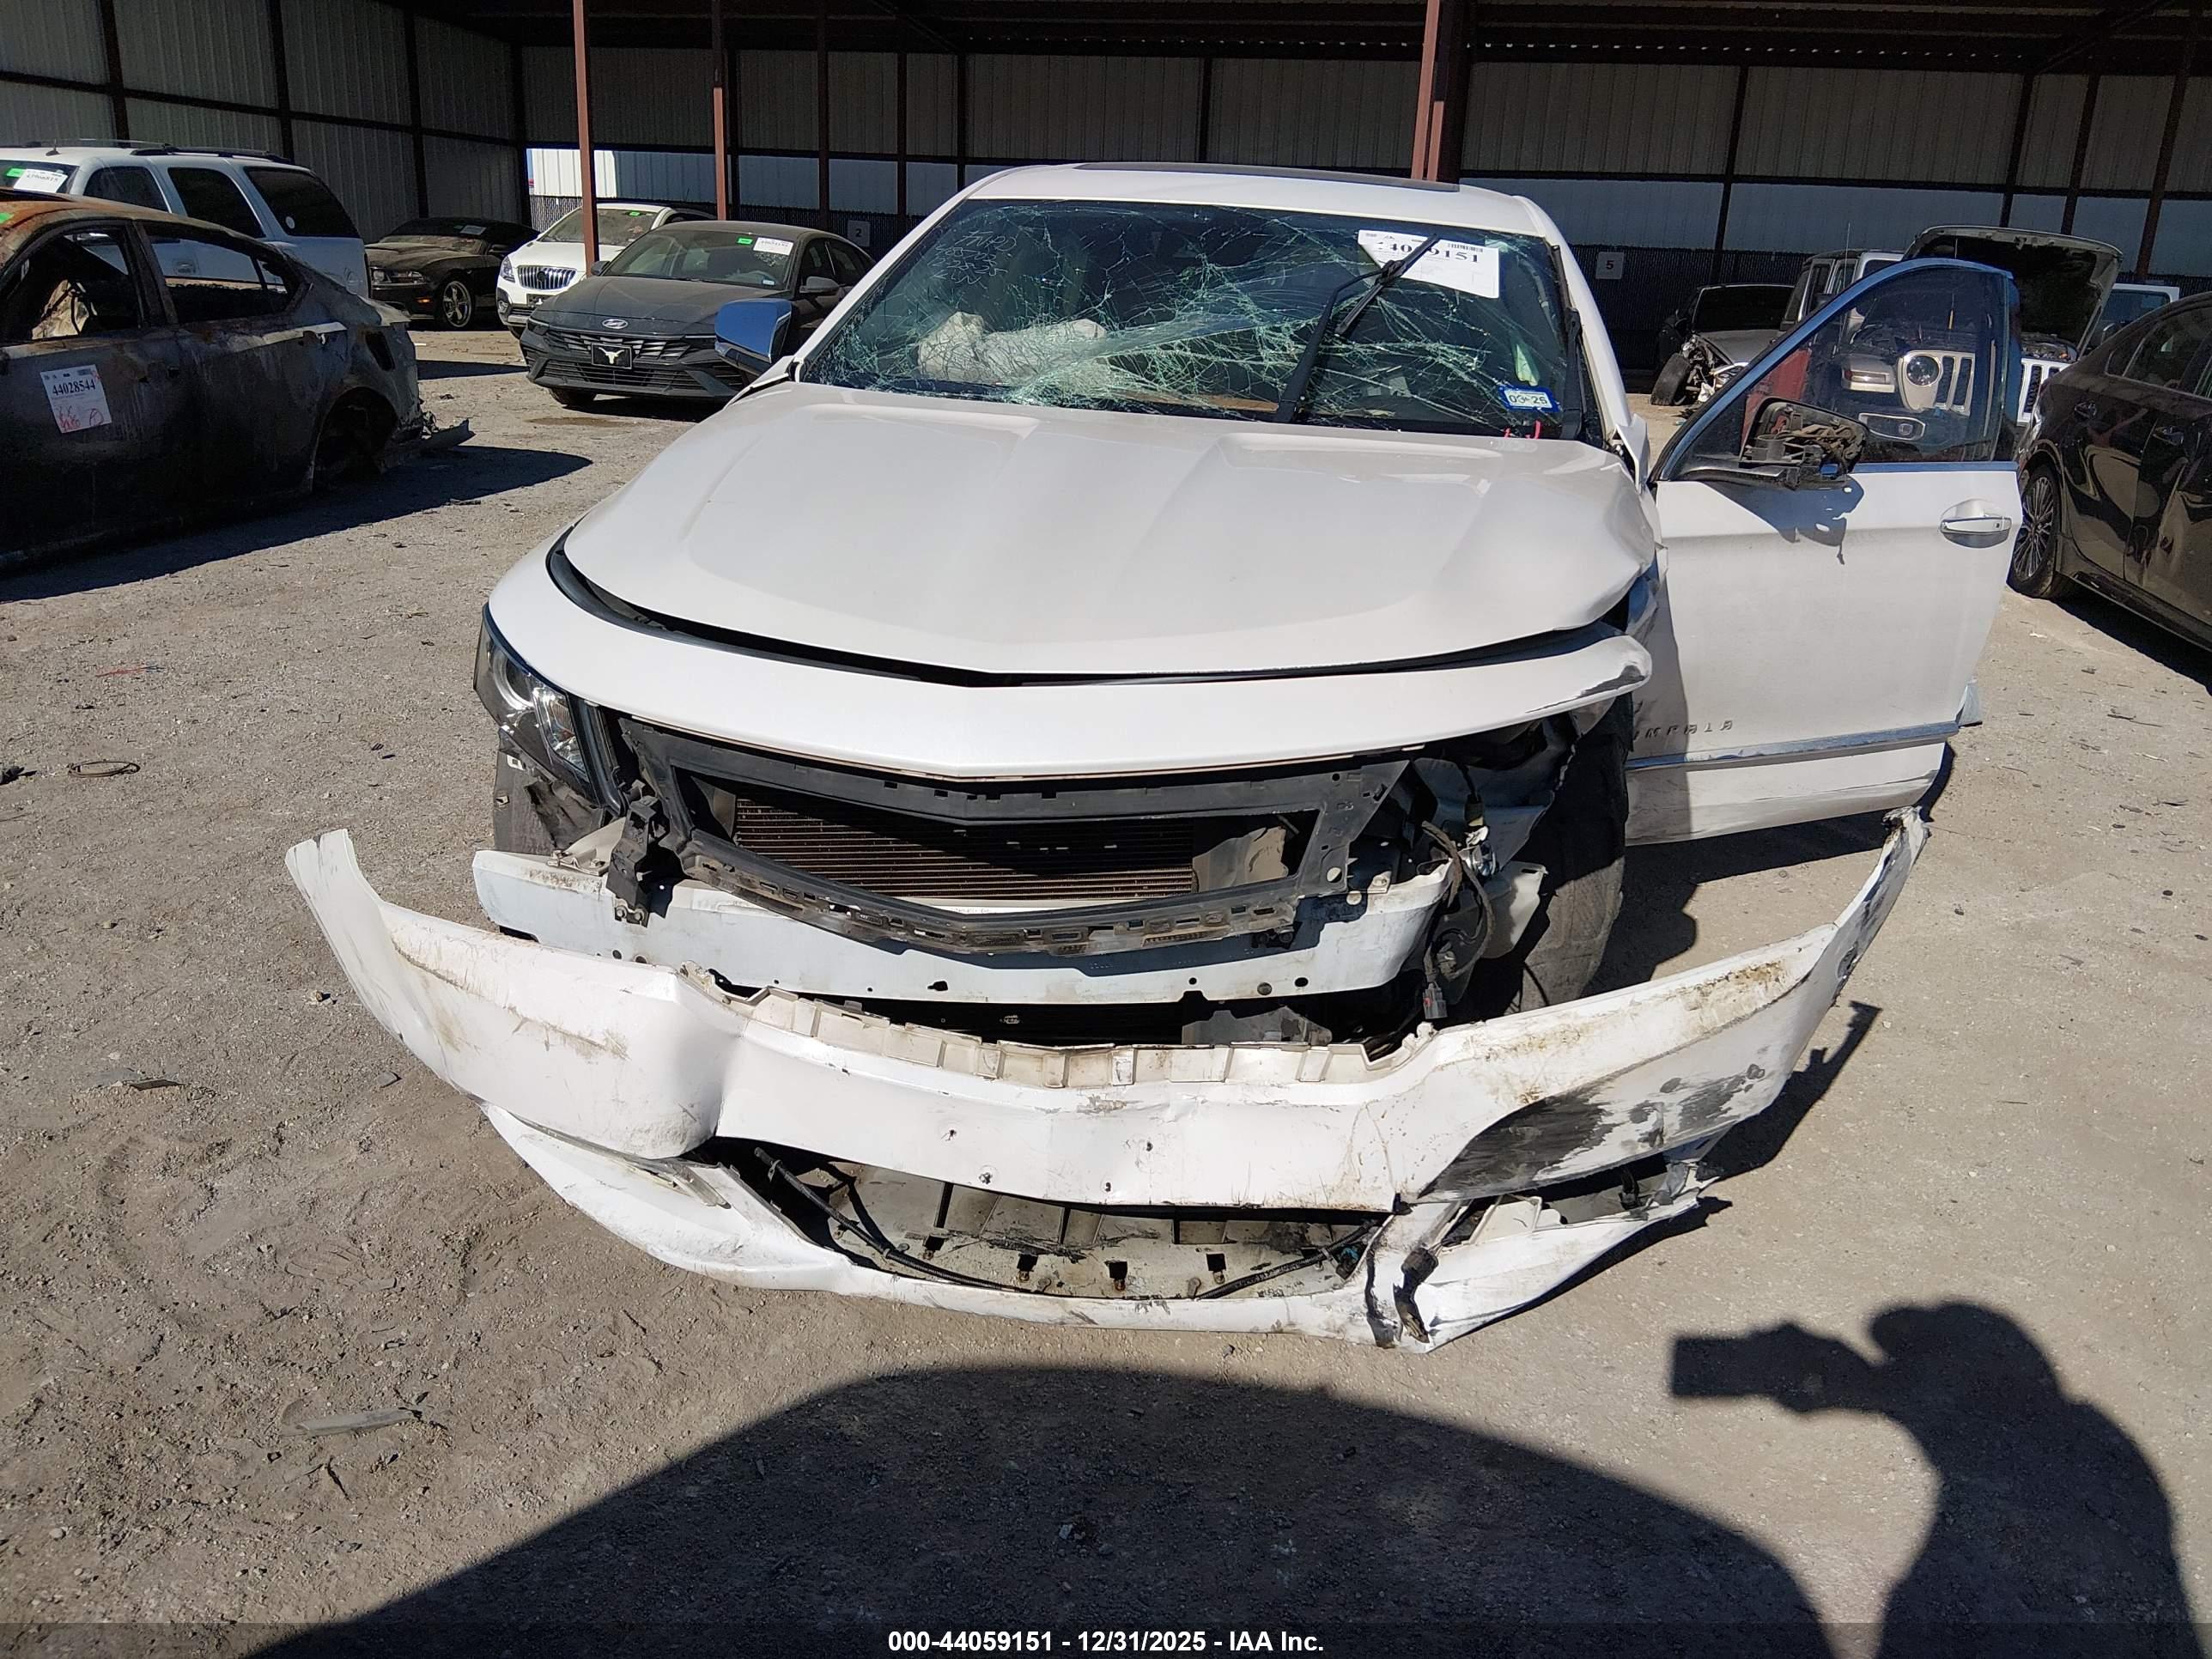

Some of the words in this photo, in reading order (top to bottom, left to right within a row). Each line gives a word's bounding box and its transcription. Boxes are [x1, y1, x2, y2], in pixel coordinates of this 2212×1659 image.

[854, 228, 863, 238] 2
[1606, 259, 1615, 270] 5
[52, 379, 96, 396] 44028544
